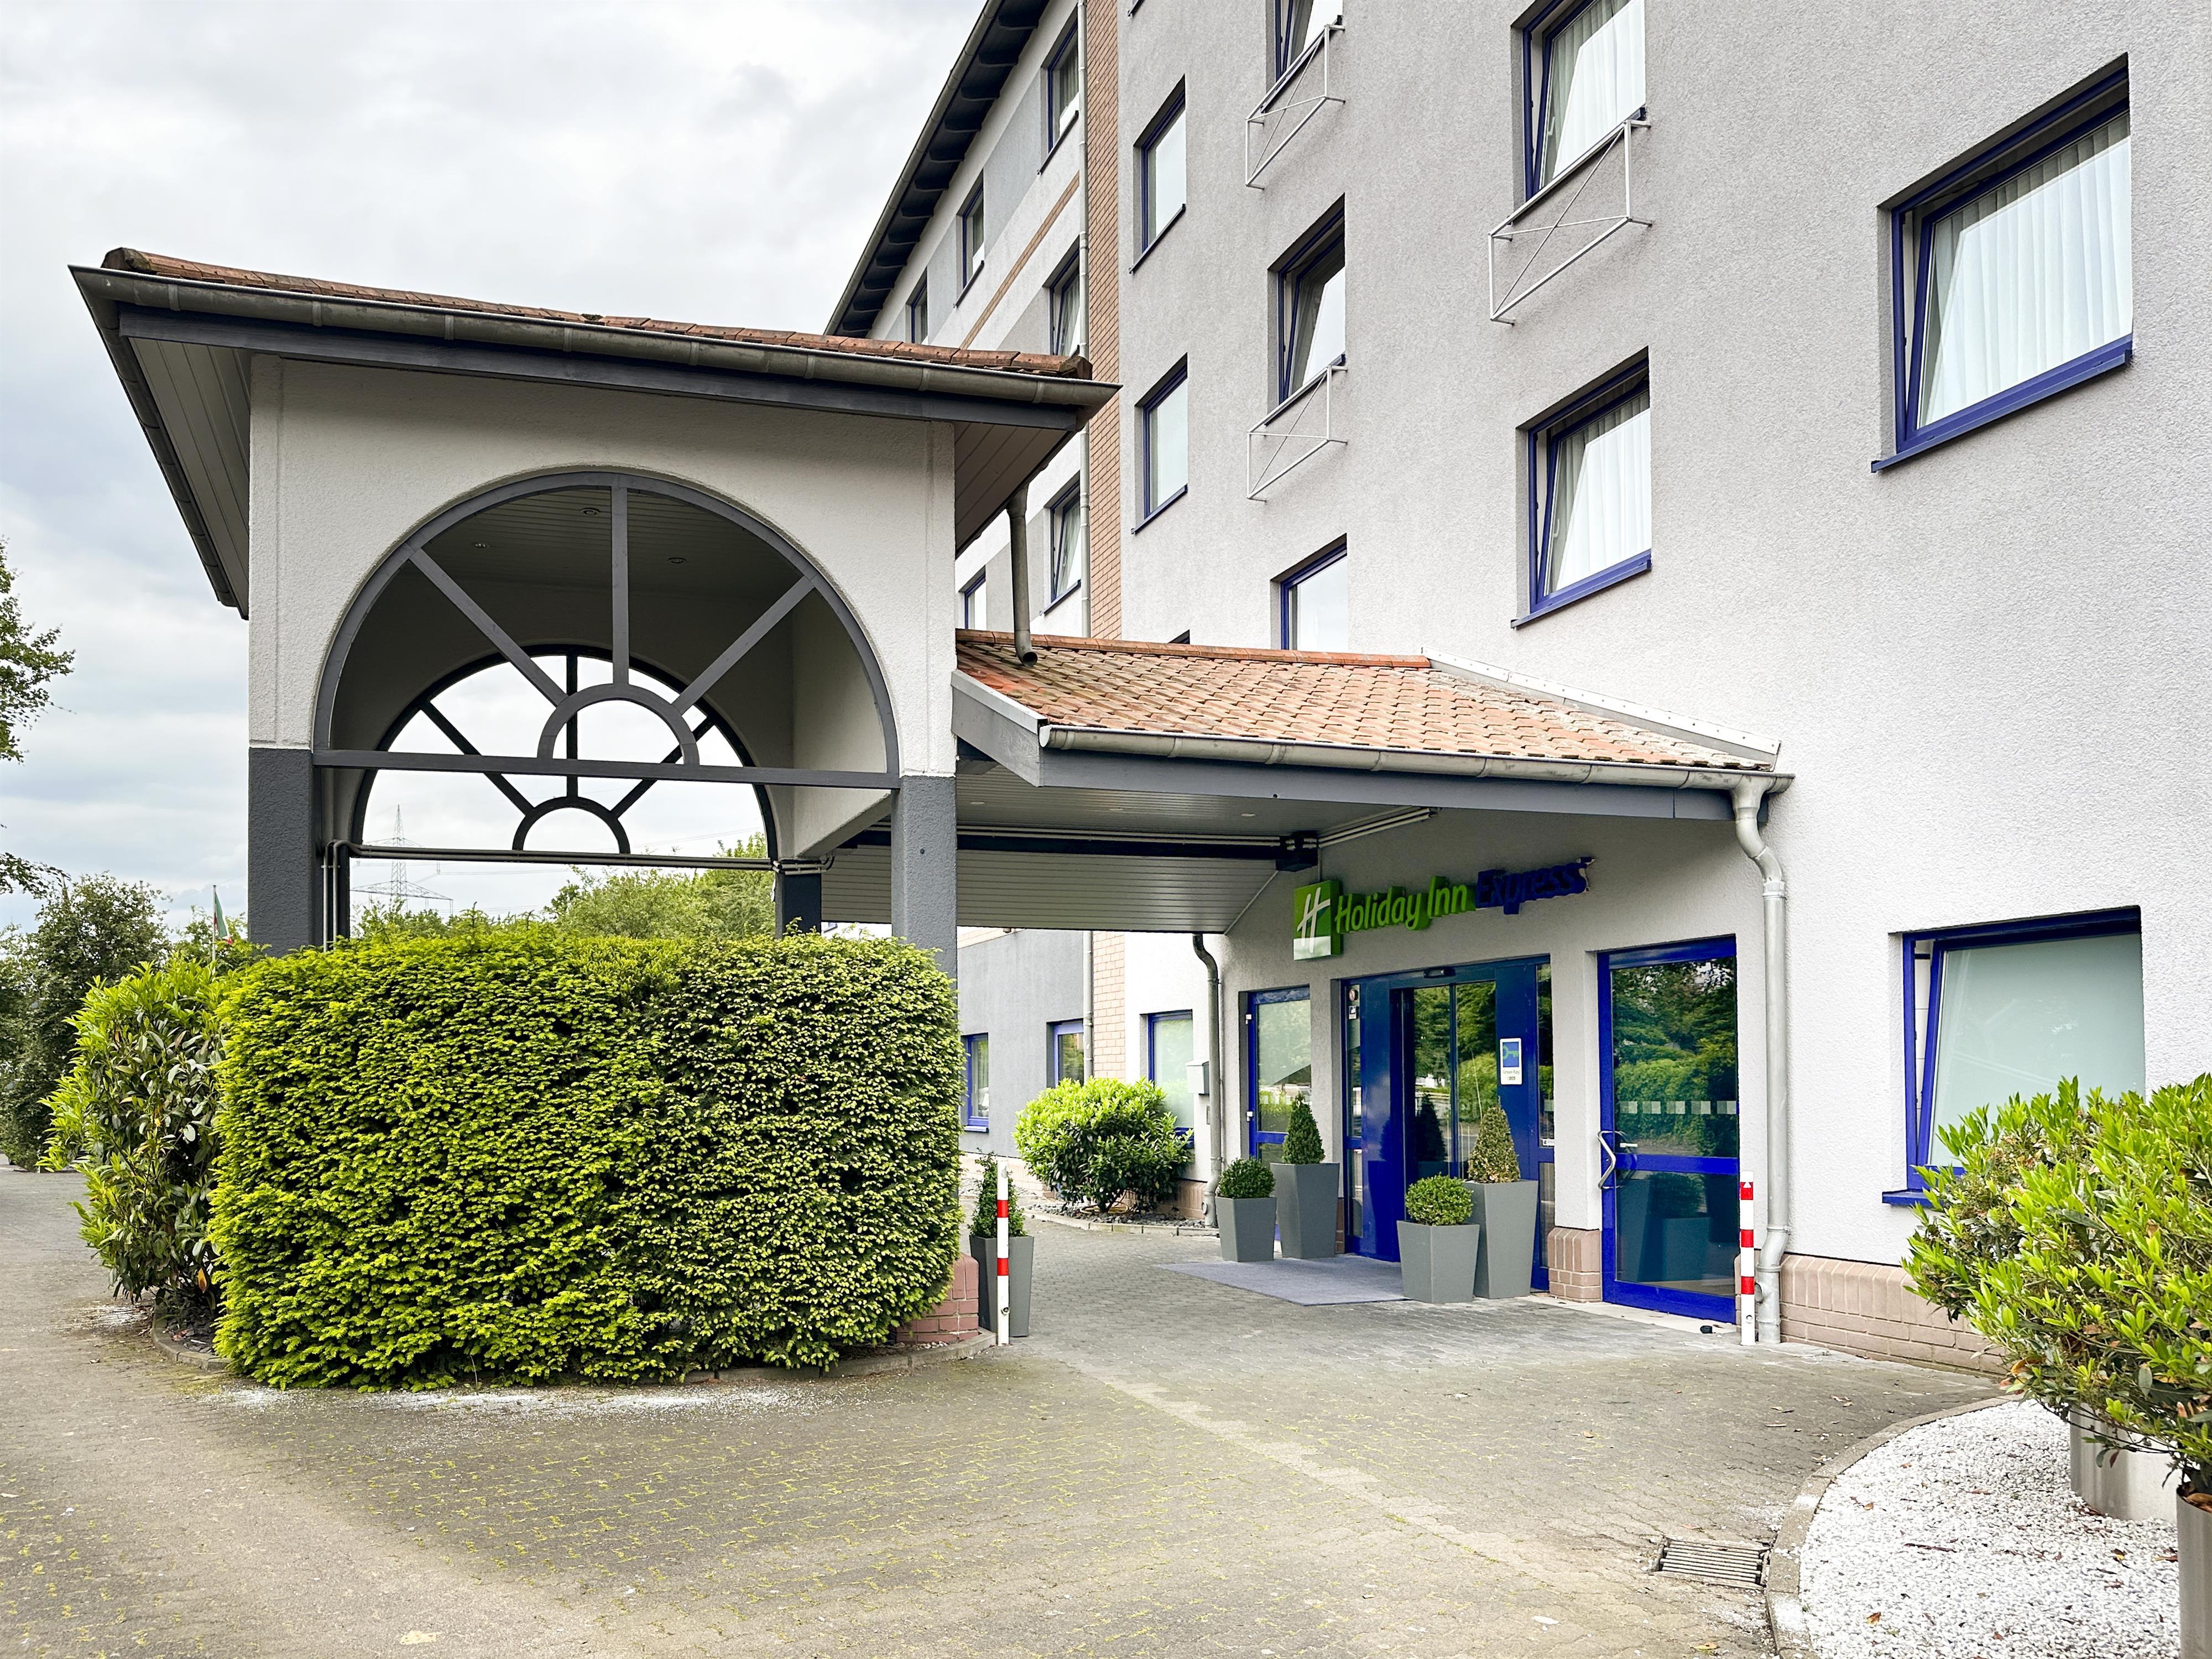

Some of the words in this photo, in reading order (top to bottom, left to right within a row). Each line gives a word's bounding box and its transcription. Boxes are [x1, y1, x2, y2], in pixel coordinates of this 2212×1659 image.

[1334, 886, 1423, 933] Holiday
[1427, 875, 1471, 918] Inn
[1475, 860, 1588, 915] Express
